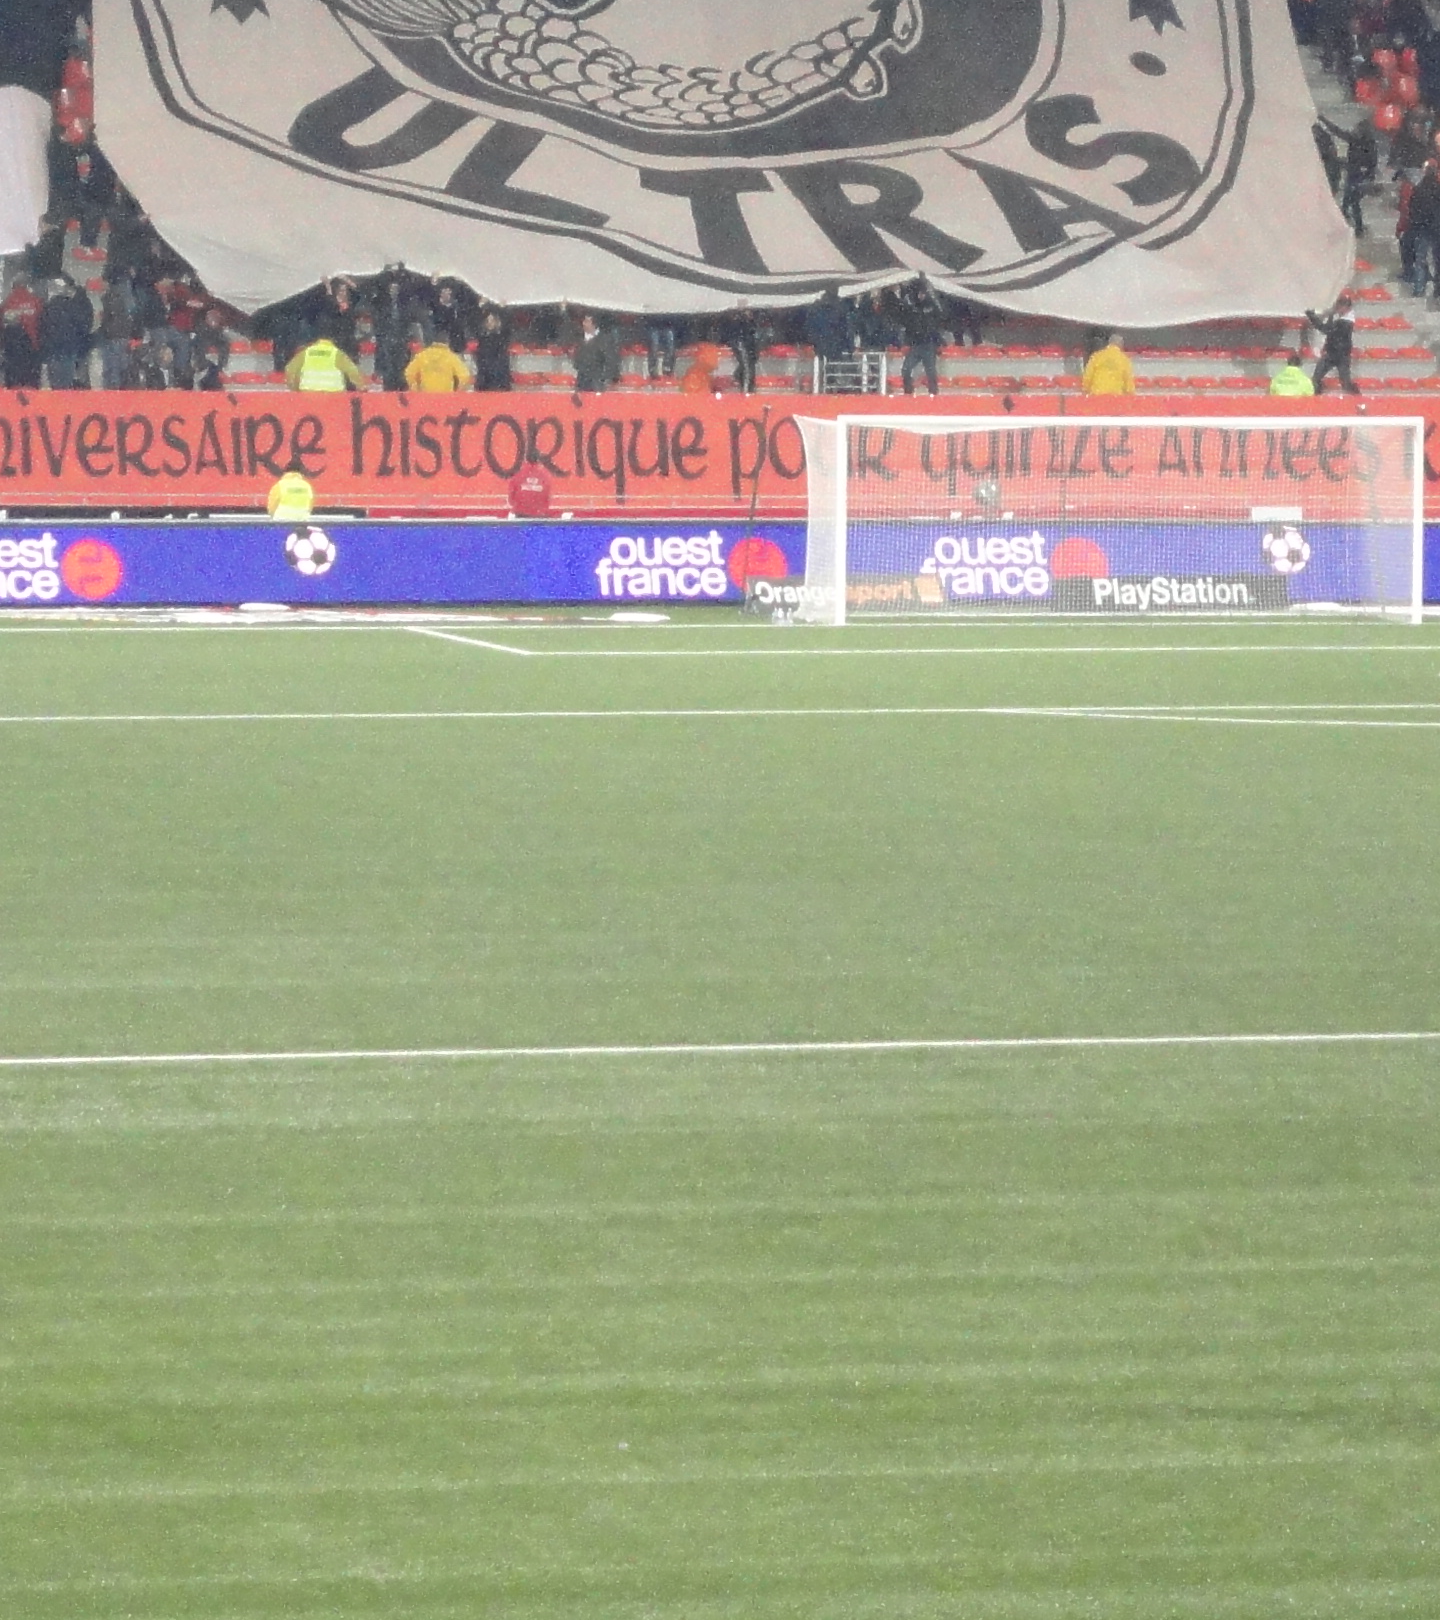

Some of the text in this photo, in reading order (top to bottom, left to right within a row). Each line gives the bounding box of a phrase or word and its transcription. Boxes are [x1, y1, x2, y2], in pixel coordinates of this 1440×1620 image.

[287, 66, 1202, 276] ULTRAS
[610, 530, 723, 566] ouest
[934, 529, 1048, 565] ouest
[595, 559, 727, 597] france
[1093, 576, 1249, 610] PlayStation
